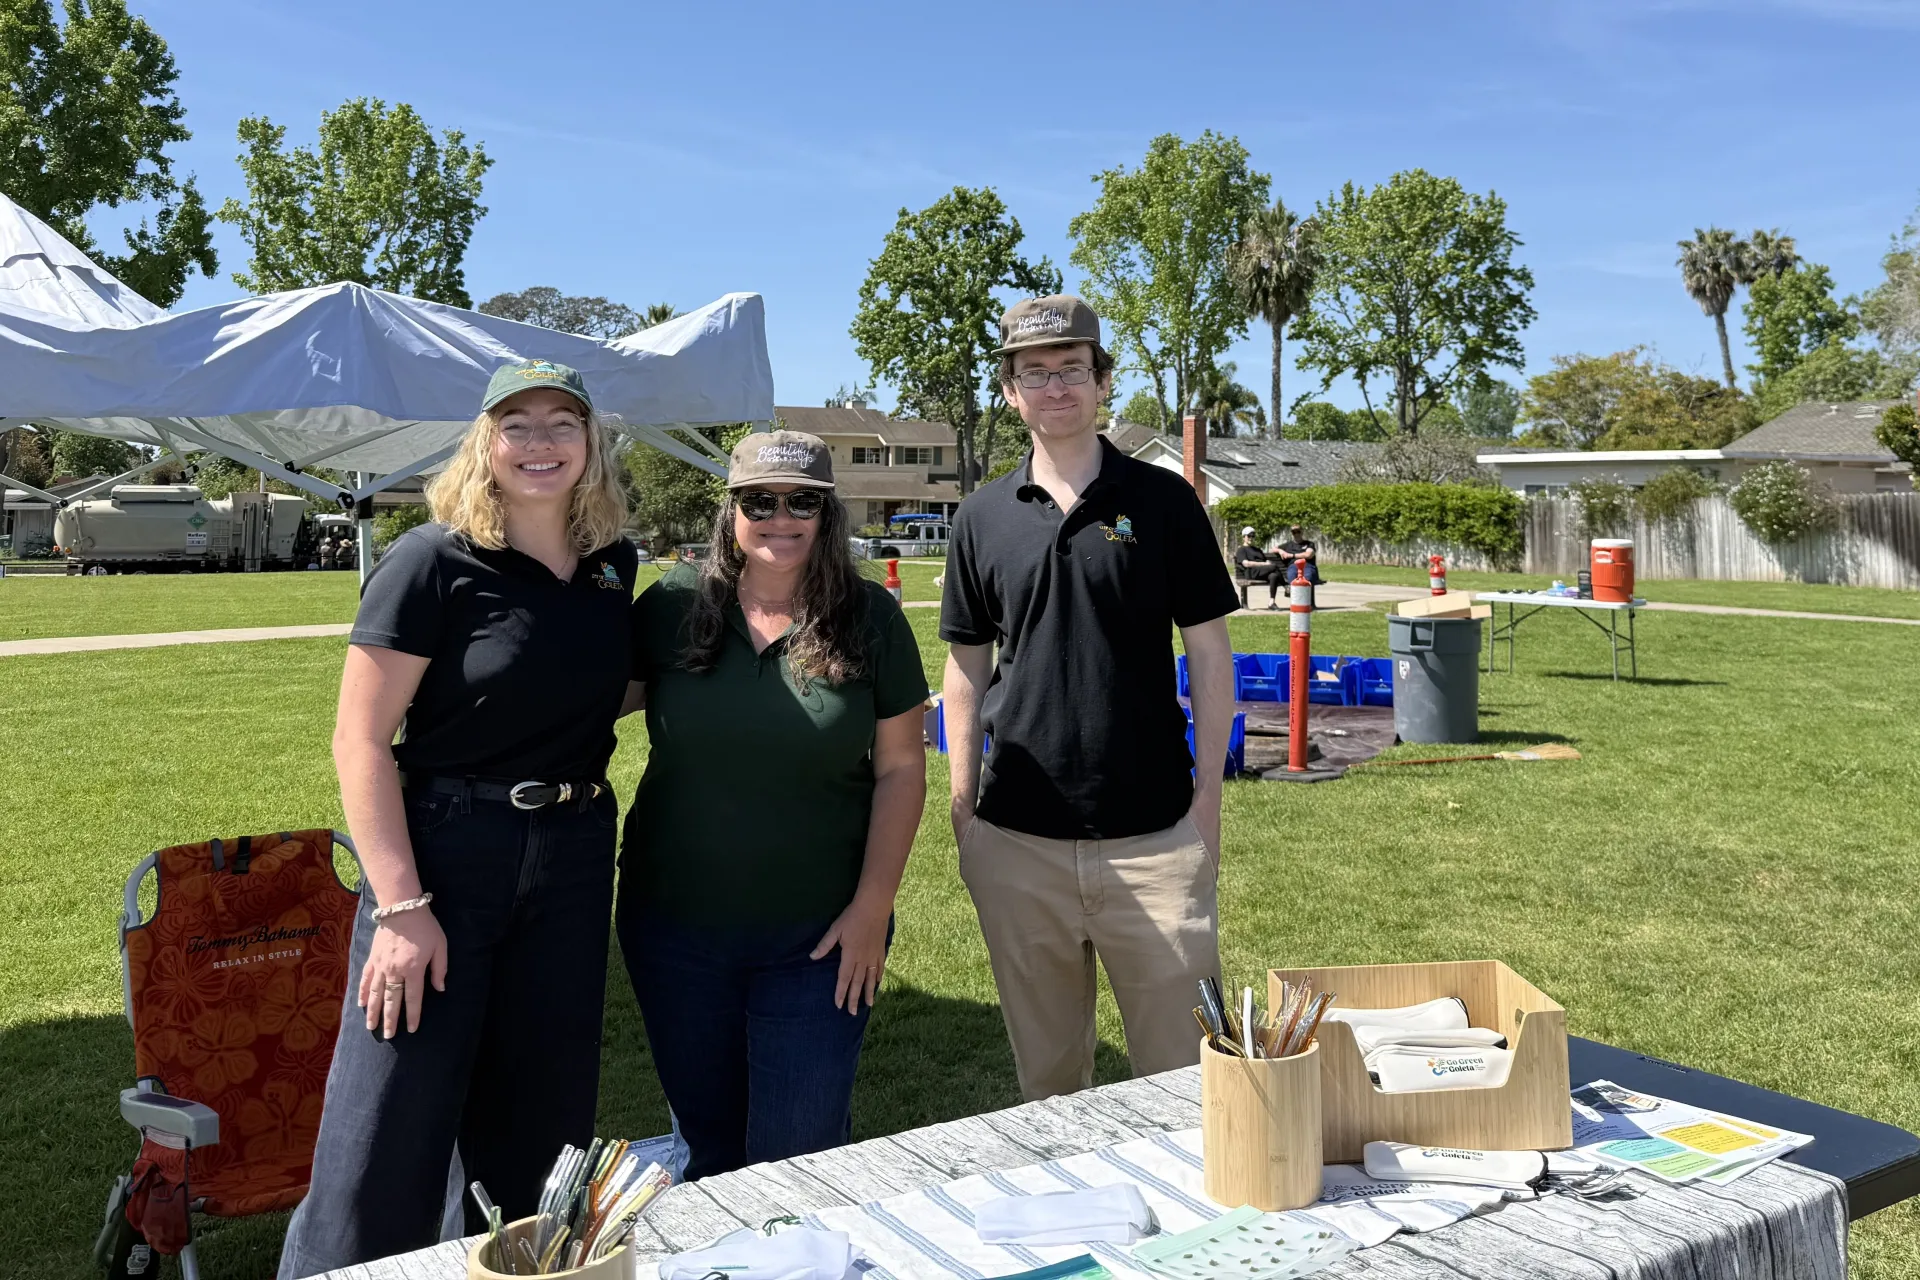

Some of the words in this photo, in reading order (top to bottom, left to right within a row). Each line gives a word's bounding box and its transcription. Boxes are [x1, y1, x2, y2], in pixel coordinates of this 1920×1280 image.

[1013, 307, 1067, 333] Beautify
[752, 442, 813, 468] Beautify
[1105, 531, 1138, 544] GOLETA
[598, 579, 625, 591] GOLETA
[186, 934, 252, 954] Tommy
[249, 924, 321, 945] Bahama
[212, 955, 250, 969] RELAX
[252, 953, 265, 962] IN
[268, 948, 303, 960] STYLE
[1458, 1057, 1484, 1065] Green
[1448, 1065, 1475, 1073] Goleta
[631, 1140, 656, 1148] TRASH
[1441, 1152, 1471, 1160] Goleta
[1354, 1188, 1411, 1197] Goleta
